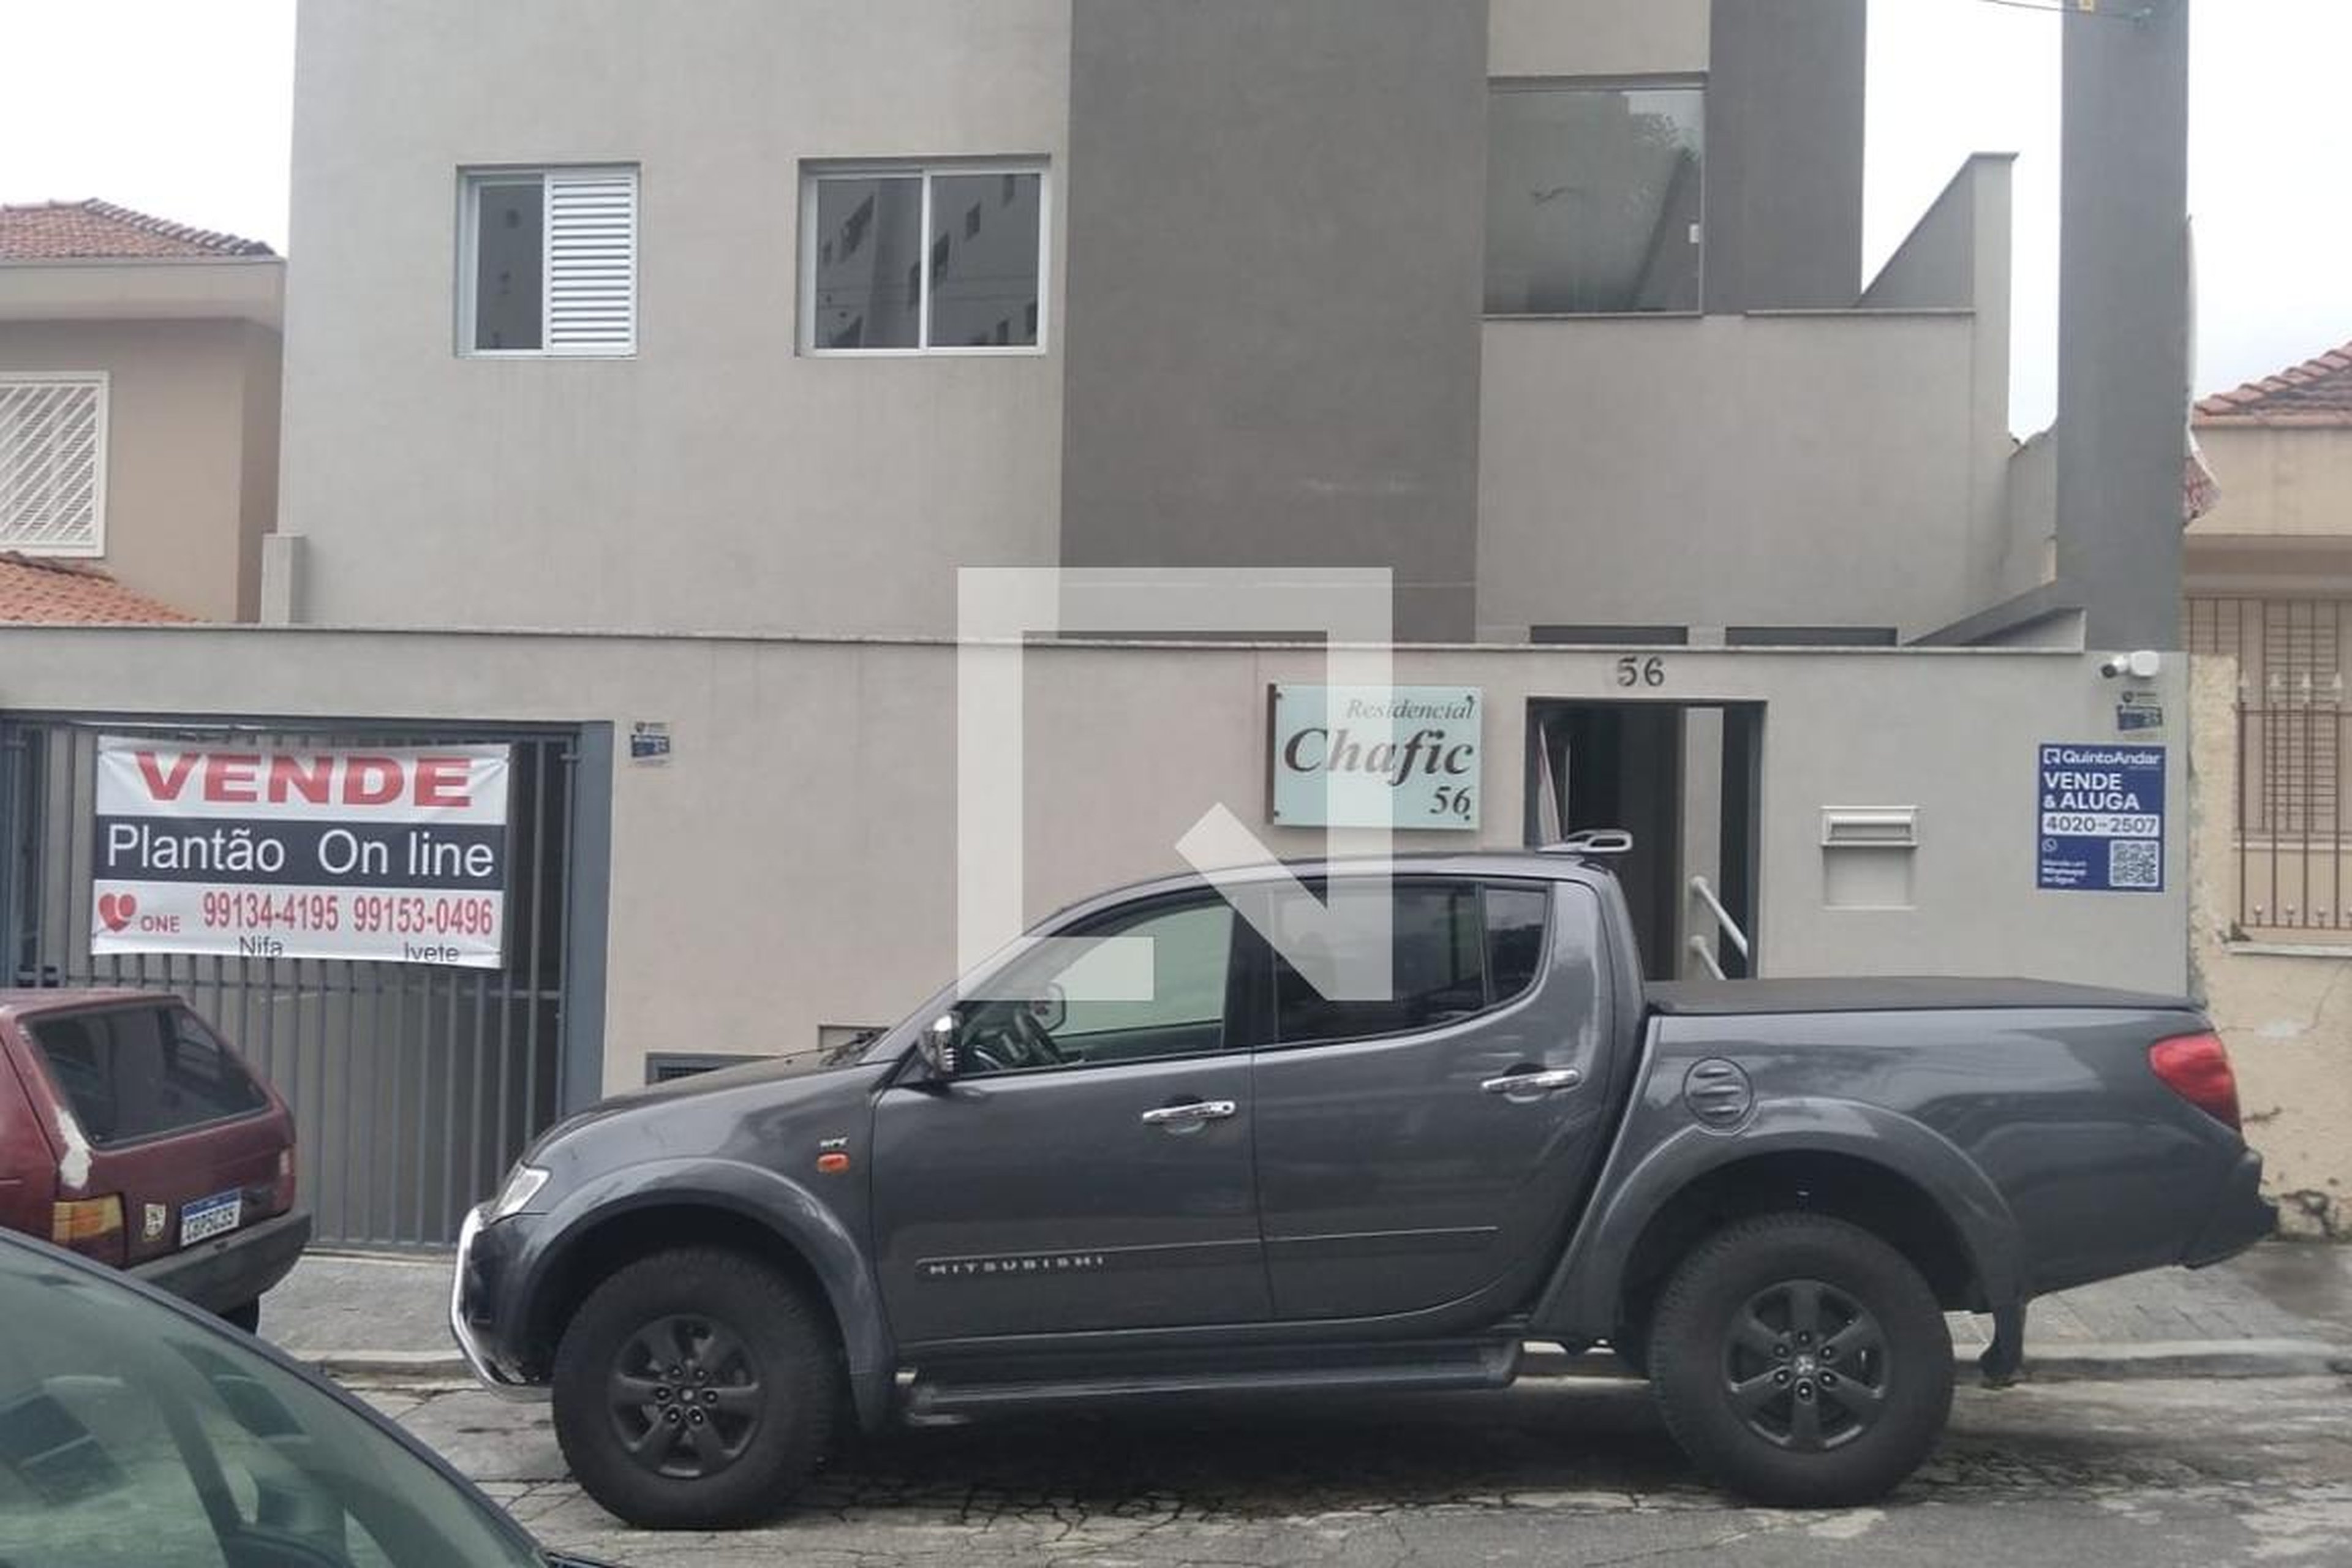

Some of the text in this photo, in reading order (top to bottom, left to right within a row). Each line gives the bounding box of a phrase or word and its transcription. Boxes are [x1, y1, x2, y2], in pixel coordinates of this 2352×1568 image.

[1617, 656, 1665, 687] 56
[1346, 698, 1474, 720] Residencial
[1284, 727, 1474, 786] Chafic
[2062, 749, 2160, 765] QuintoAndar
[134, 751, 473, 807] VENDE
[2043, 772, 2122, 791] VENDE
[1429, 786, 1472, 815] 56
[2059, 791, 2141, 810] ALUGA
[2046, 815, 2157, 833] 4020-2507
[108, 824, 494, 876] Plantão On line
[140, 914, 180, 933] ONE
[202, 891, 492, 936] 99134-4195 99153-0496
[239, 936, 459, 962] Nifa Ivete
[929, 1256, 1103, 1275] MITSUBISHI
